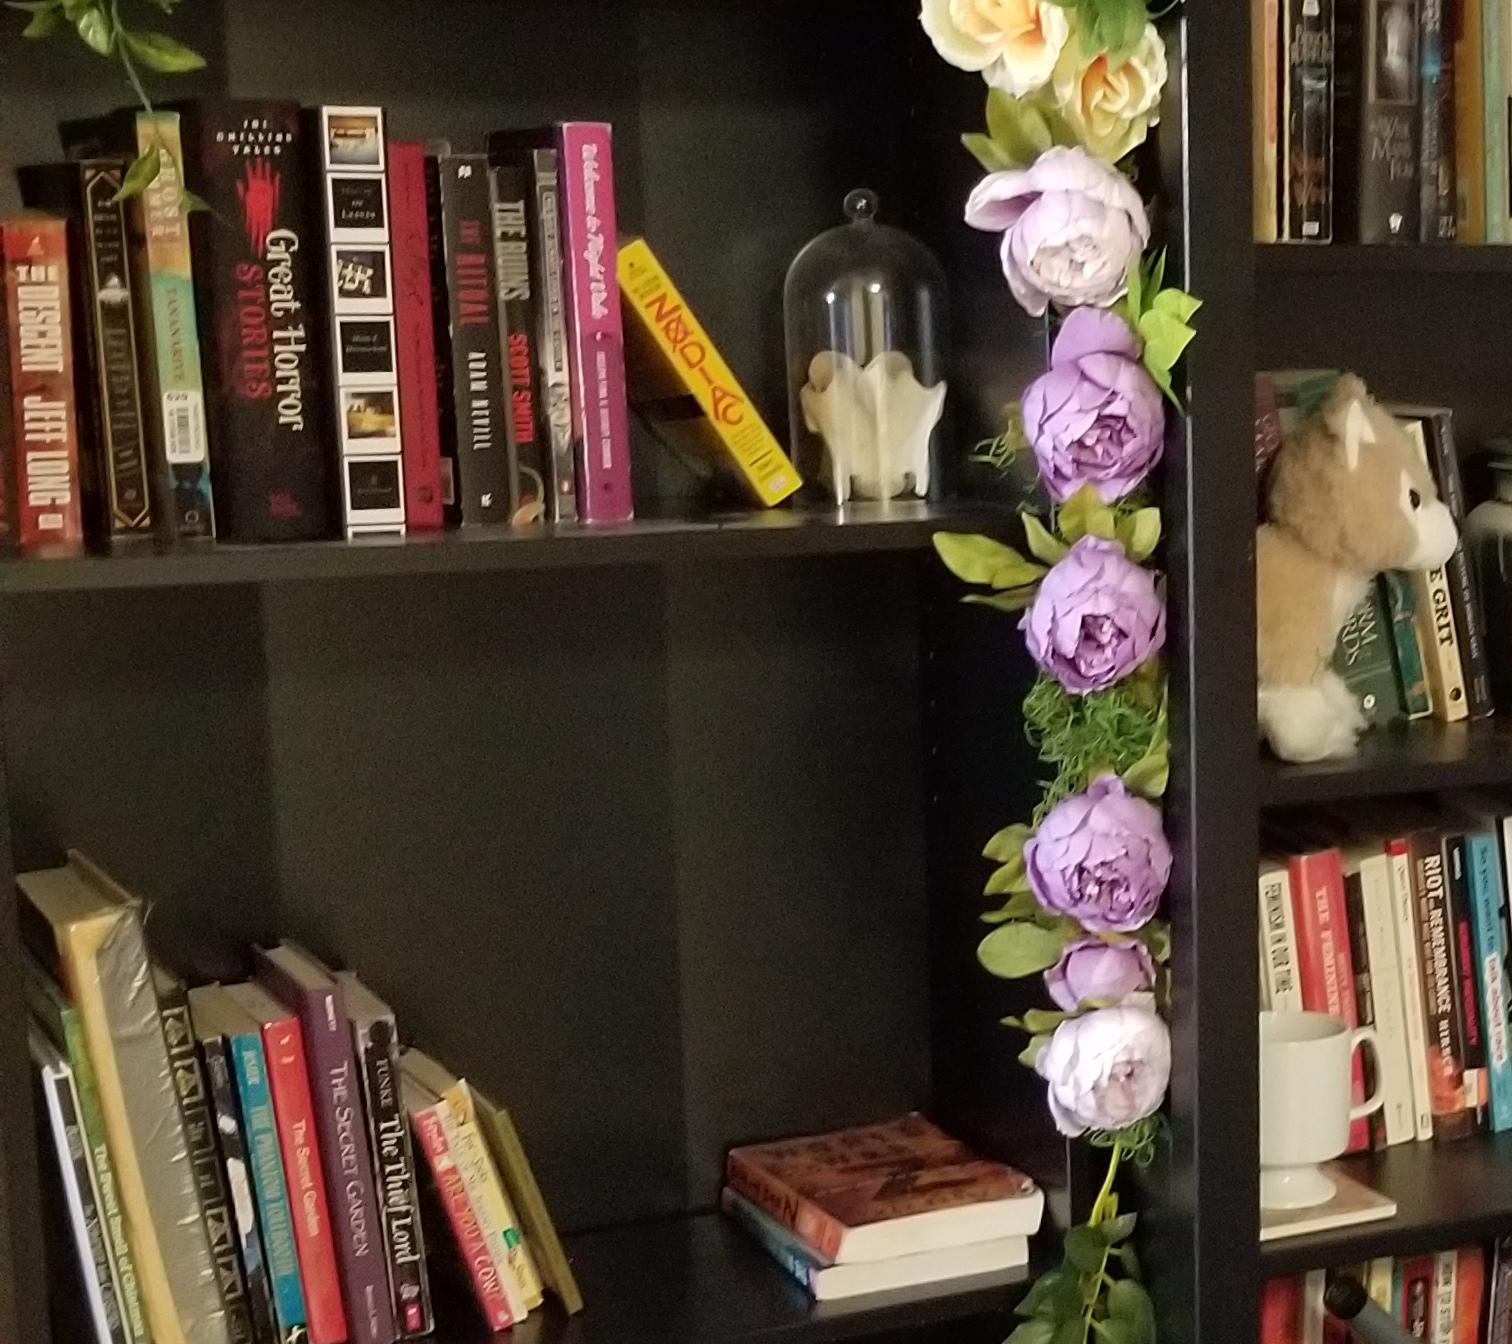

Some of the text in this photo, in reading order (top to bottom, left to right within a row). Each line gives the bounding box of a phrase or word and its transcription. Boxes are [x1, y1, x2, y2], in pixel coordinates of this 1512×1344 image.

[497, 201, 526, 236] THE
[16, 265, 59, 283] THE
[236, 262, 273, 400] STORIES
[265, 228, 307, 432] Great Horror
[508, 334, 531, 384] SCOTT
[17, 285, 72, 508] DESCENT JEFF LONG
[1432, 588, 1455, 647] GRIT
[1423, 854, 1444, 899] RIOT
[1315, 886, 1330, 924] THE
[1428, 908, 1452, 1014] REMEMBRANCE
[329, 1060, 370, 1257] THE SECRET GARDEN
[379, 1114, 404, 1156] The
[296, 1143, 313, 1189] Secret
[384, 1156, 412, 1215] Thief
[392, 1215, 421, 1265] Lord
